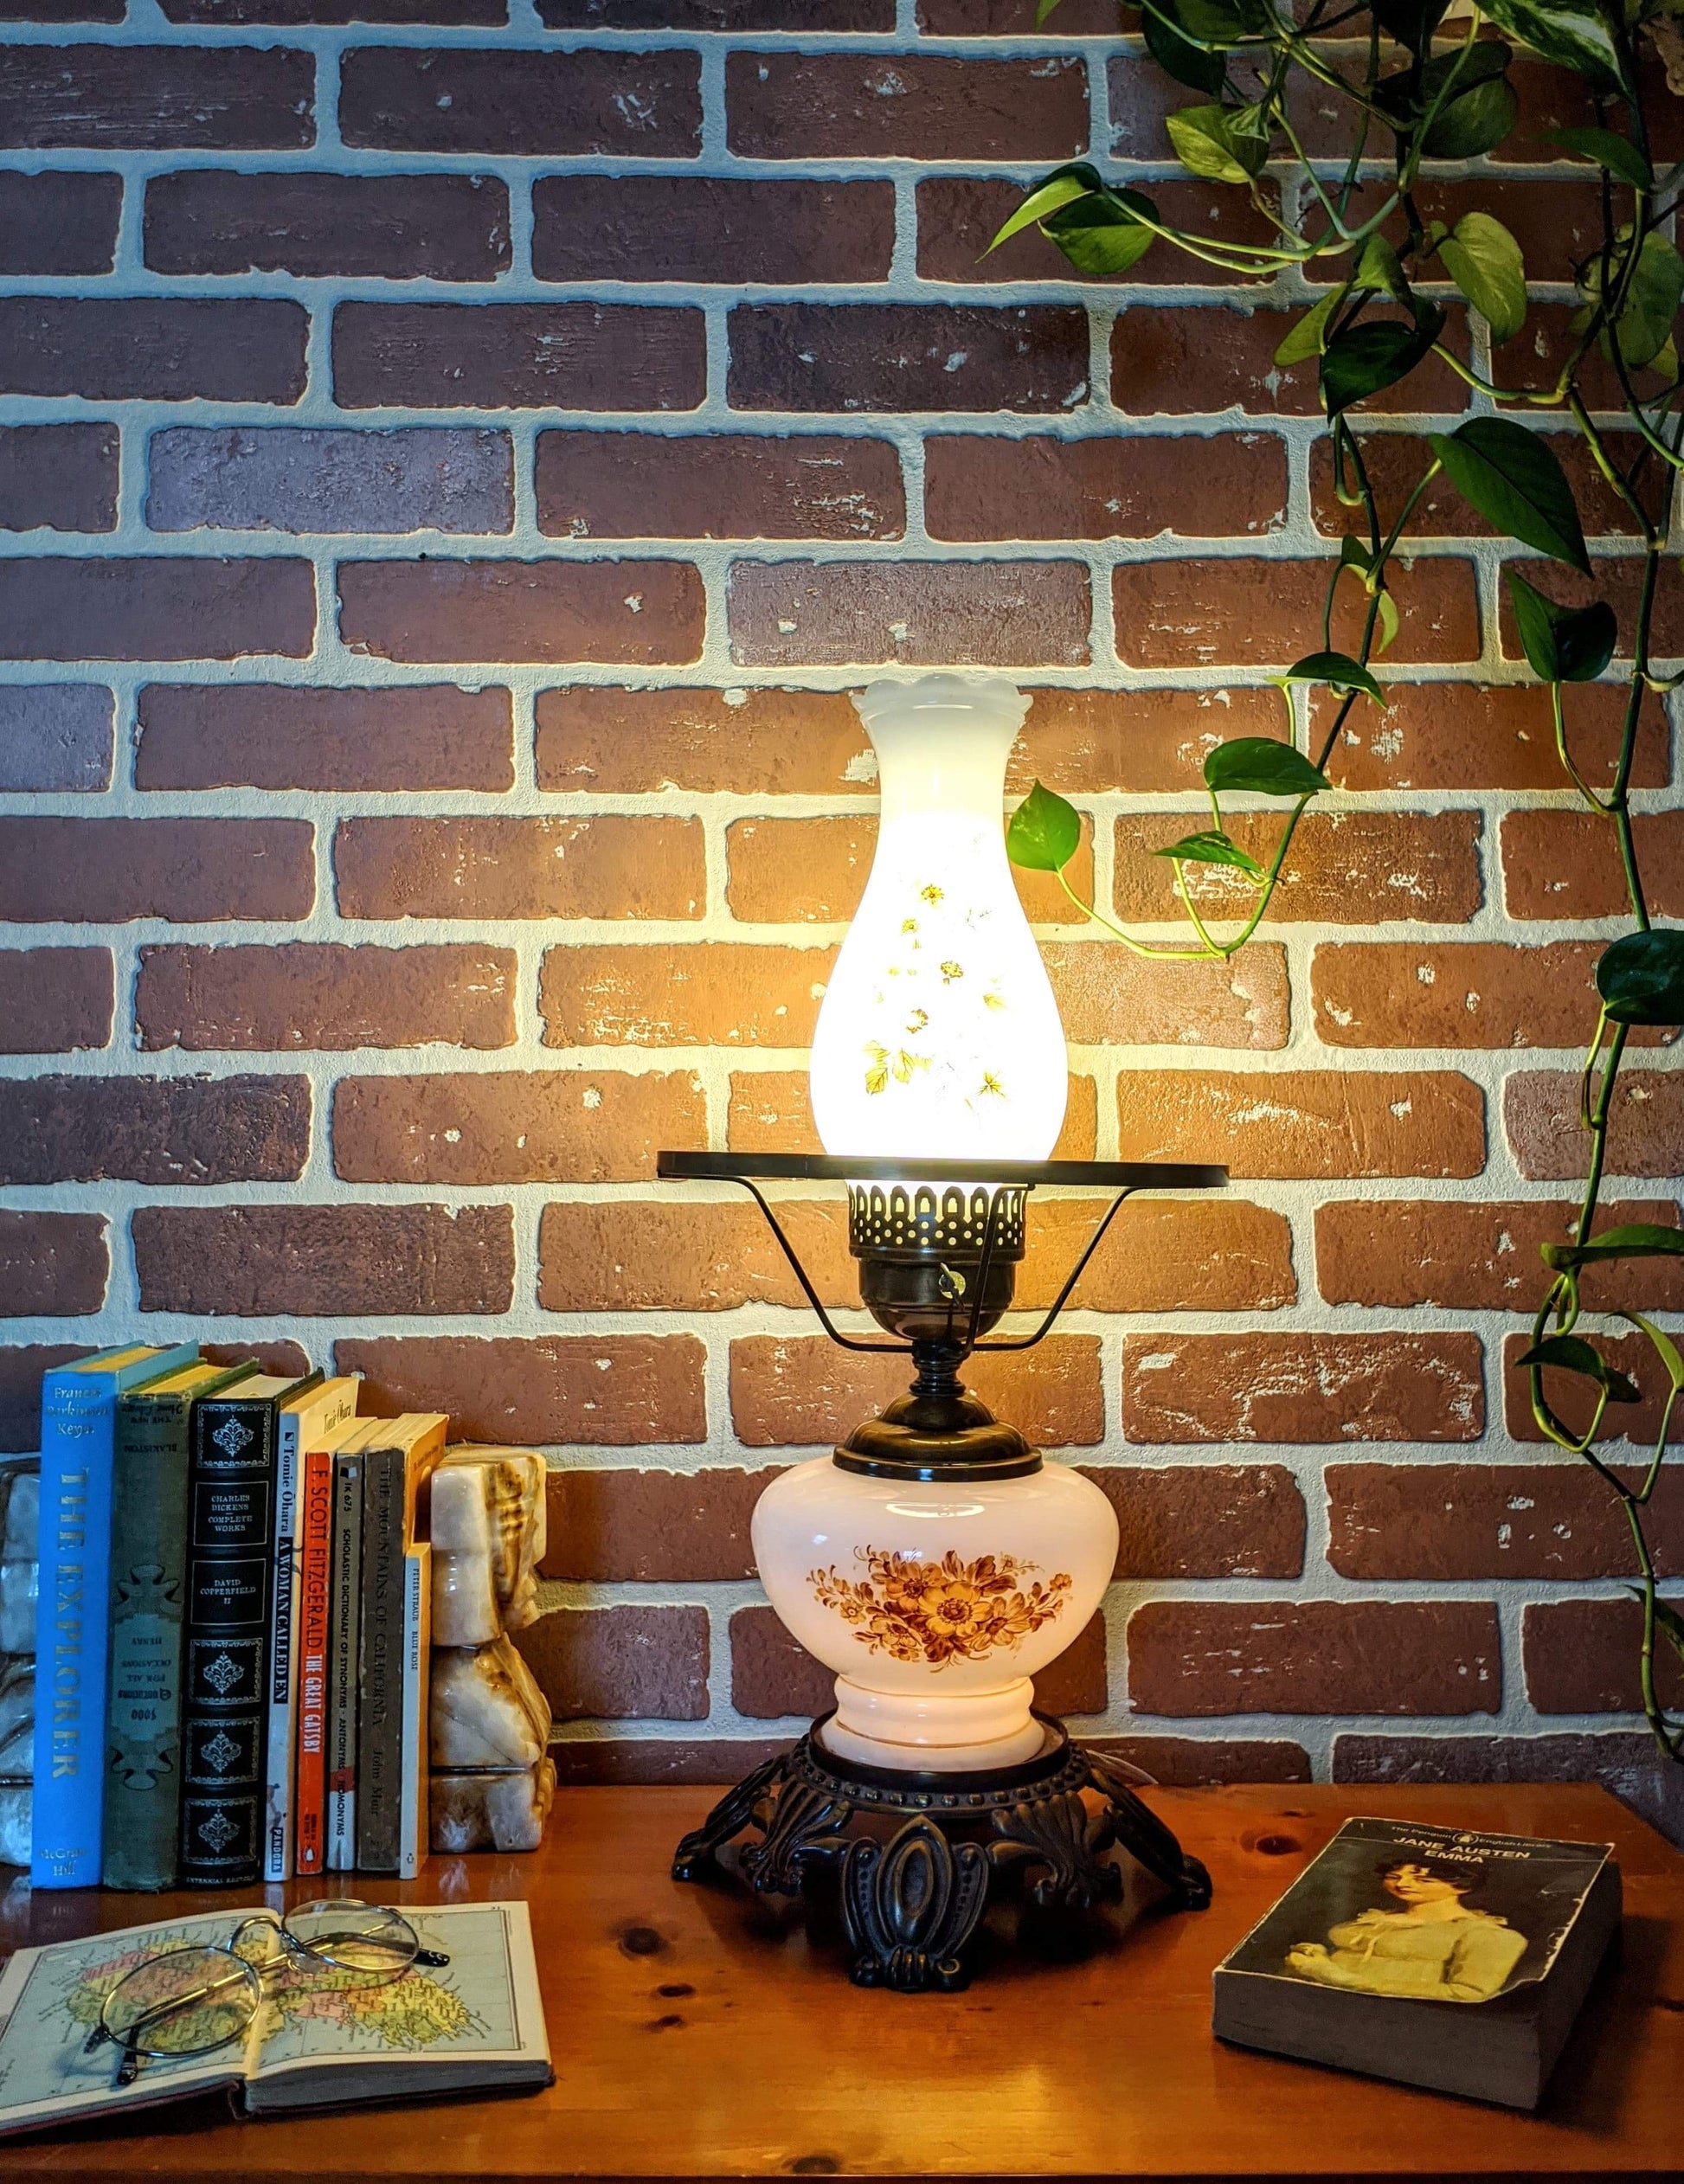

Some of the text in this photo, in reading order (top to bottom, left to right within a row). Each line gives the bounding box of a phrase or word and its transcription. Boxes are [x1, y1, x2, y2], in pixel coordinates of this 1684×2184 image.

[124, 1444, 177, 1454] BLAKISTON
[282, 1446, 295, 1487] Tomie
[211, 1494, 250, 1503] CHARLES
[211, 1503, 249, 1512] DICKENS
[344, 1495, 352, 1512] 675
[305, 1469, 328, 1648] F. SCOTT FITZGERALD
[200, 1586, 256, 1596] COPPERFIELD
[372, 1466, 391, 1726] THE MOUNTAINS OF CALIFORNIA
[275, 1540, 291, 1699] A WOMAN CALLED EN
[411, 1592, 420, 1622] STRAUB
[52, 1467, 89, 1779] THE EXPLORER
[126, 1674, 166, 1683] FOR ALL
[336, 1529, 351, 1836] SCHOLASTIC DICTIONARY OF SYNONYMS ANTONYMS HOMONYMS
[131, 1708, 157, 1721] 5000
[304, 1654, 323, 1753] THE GREAT GATSBY
[370, 1750, 383, 1816] John Muir
[273, 1828, 282, 1871] PANDORA
[1392, 1837, 1531, 1859] JANE AUSTEN
[1424, 1850, 1484, 1864] EMMA
[53, 1860, 77, 1876] Hill
